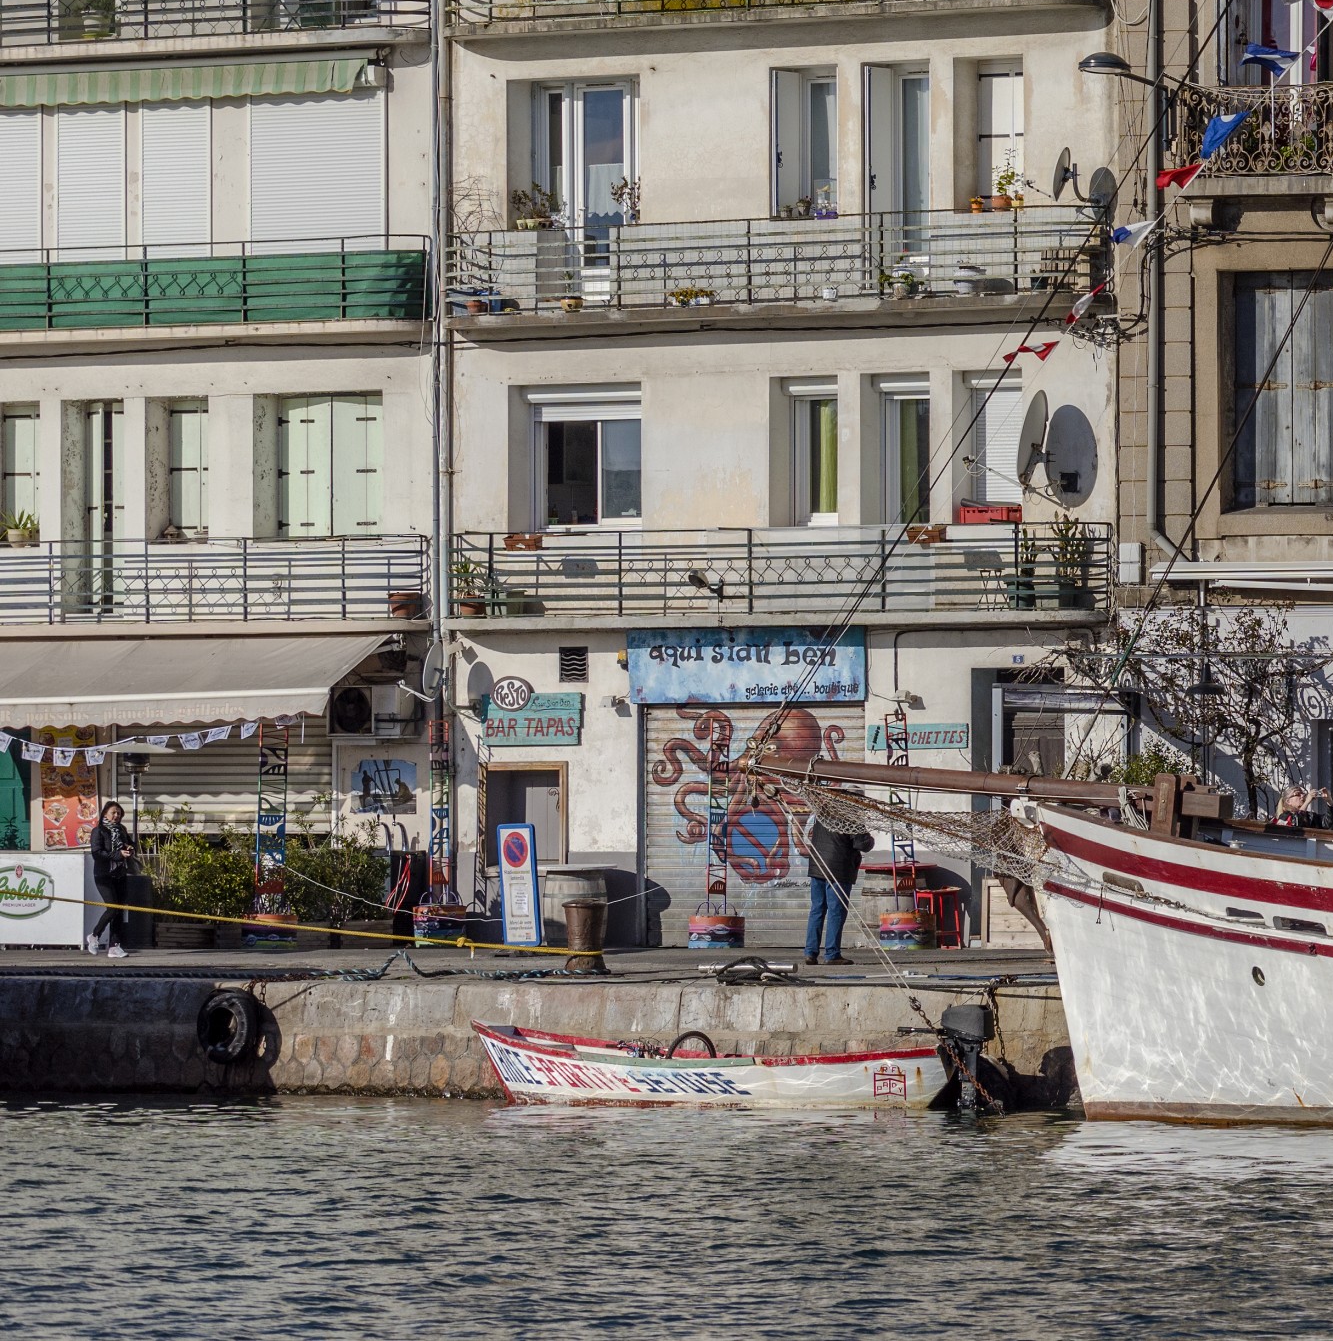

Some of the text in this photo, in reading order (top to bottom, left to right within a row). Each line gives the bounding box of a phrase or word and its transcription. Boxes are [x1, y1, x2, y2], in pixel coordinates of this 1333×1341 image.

[649, 637, 837, 668] aqui sian ben
[745, 683, 779, 700] galerie
[813, 681, 859, 698] boutique
[26, 709, 89, 725] poissons
[103, 706, 163, 725] plancha
[178, 703, 245, 717] grillades
[485, 716, 576, 738] BAR TAPAS
[524, 1054, 643, 1093] SPORTIVE
[626, 1069, 752, 1096] SETOISE
